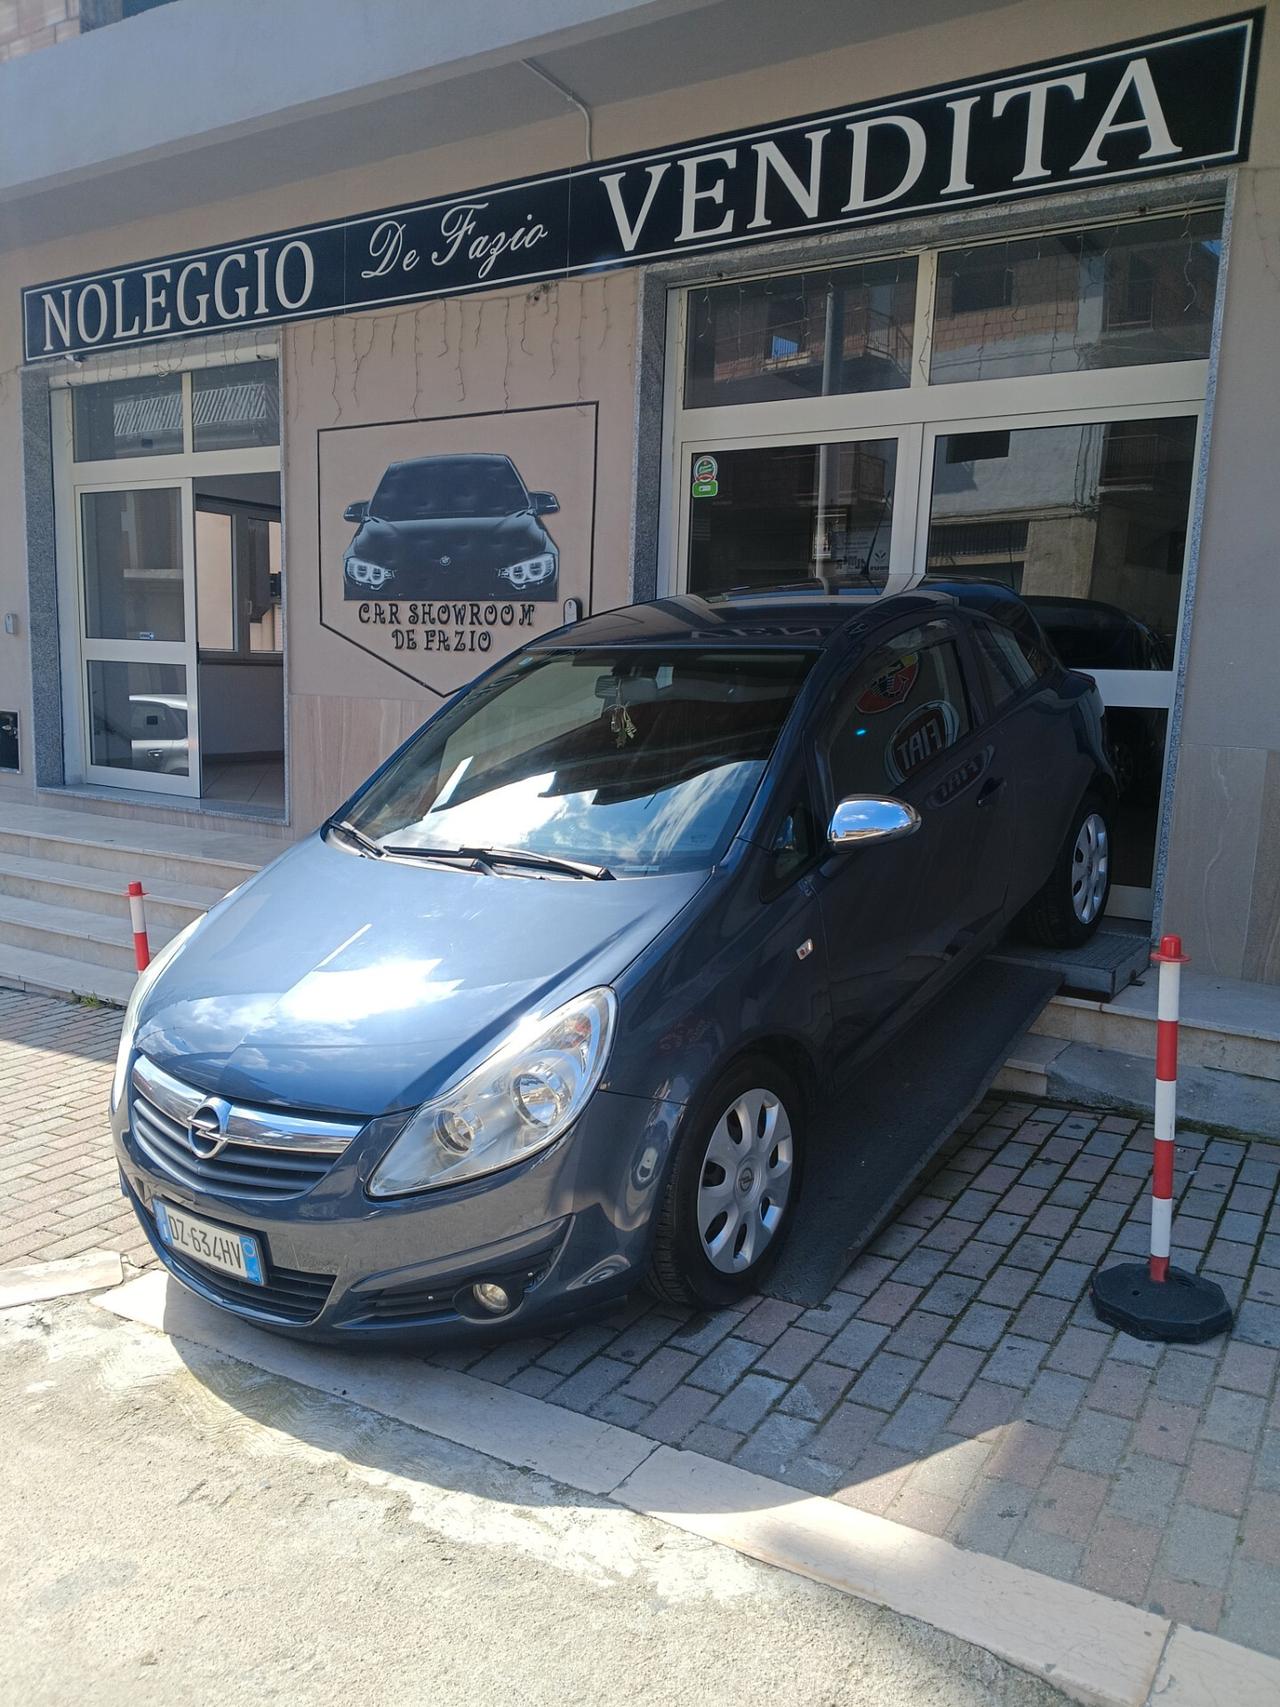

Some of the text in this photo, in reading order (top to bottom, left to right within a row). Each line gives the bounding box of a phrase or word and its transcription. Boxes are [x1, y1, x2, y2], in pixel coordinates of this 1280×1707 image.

[599, 57, 1183, 252] VENDITA
[361, 202, 549, 279] De Fazio
[41, 240, 315, 351] NOLEGGIO
[358, 602, 535, 626] CAR SHOWROOM
[392, 629, 492, 652] DE FAZIO
[190, 1227, 242, 1269] 634HV
